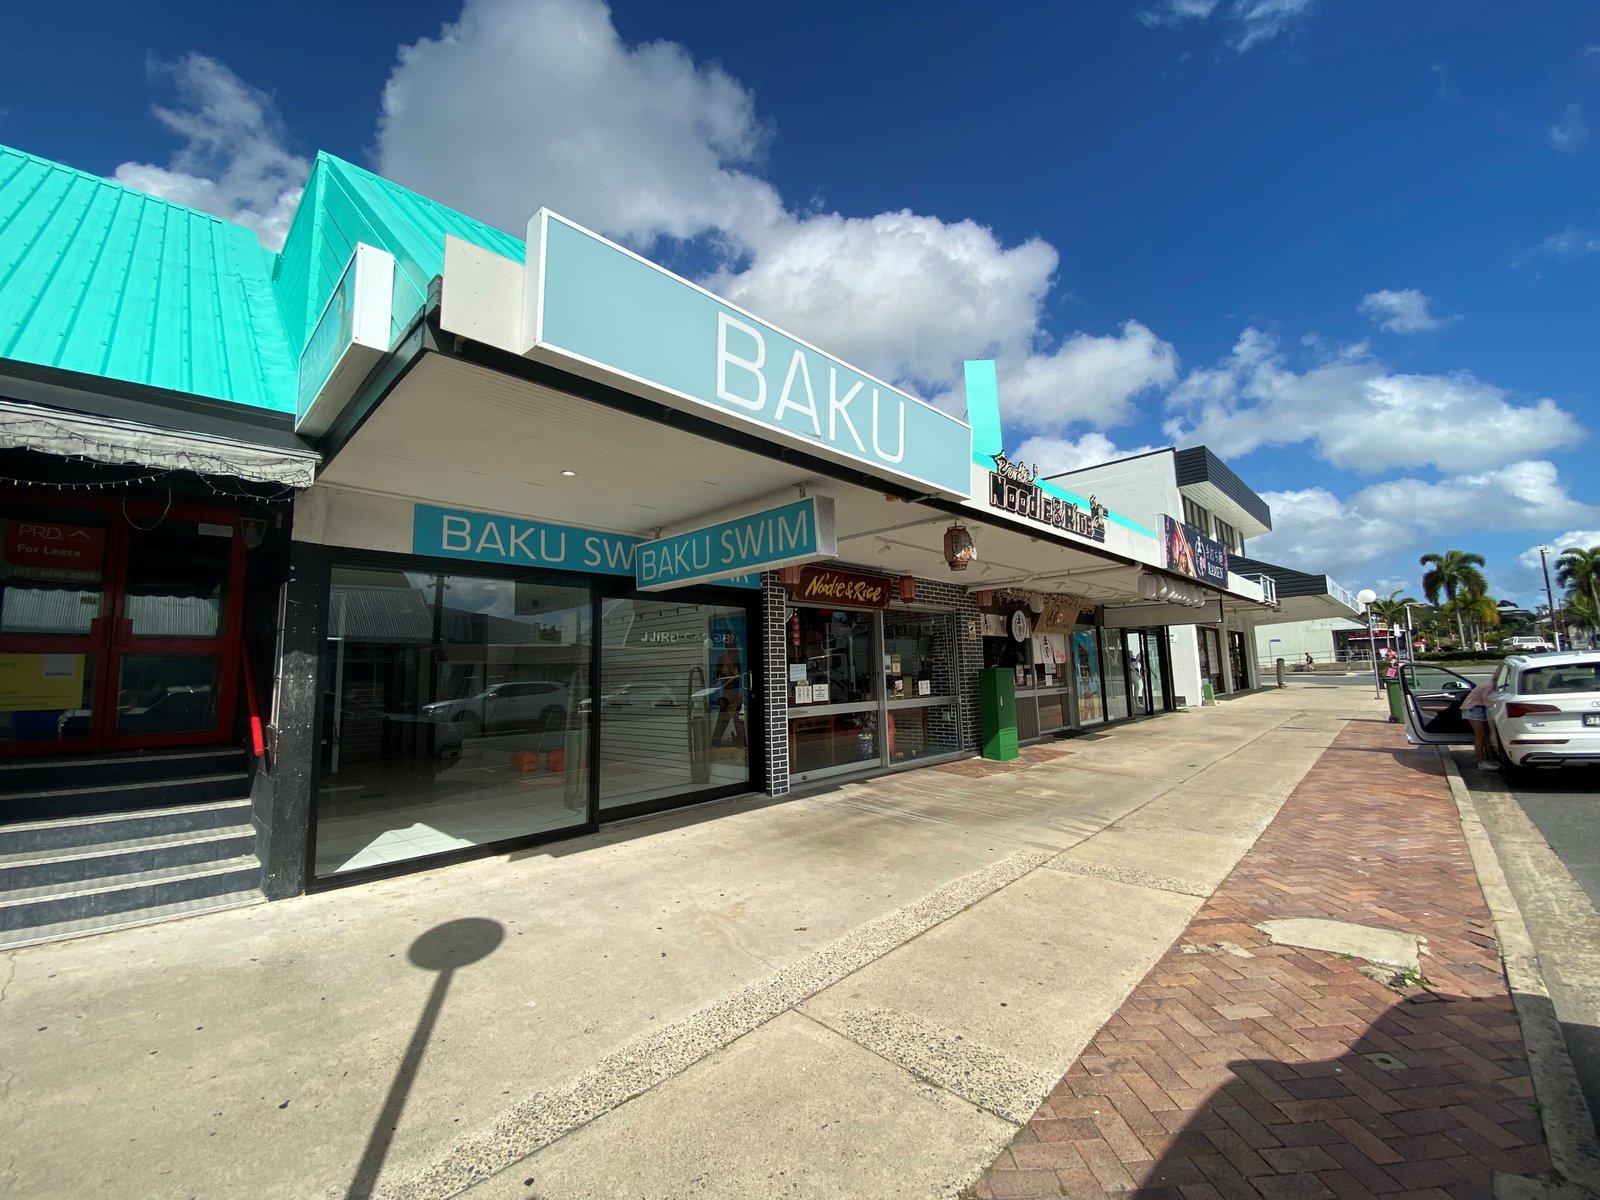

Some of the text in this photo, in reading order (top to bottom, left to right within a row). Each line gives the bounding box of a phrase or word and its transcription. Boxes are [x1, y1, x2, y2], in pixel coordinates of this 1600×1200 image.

[716, 310, 905, 464] BAKU
[17, 543, 81, 558] For Lease
[441, 514, 635, 569] BAKU SW
[642, 510, 808, 581] BAKU SWIM
